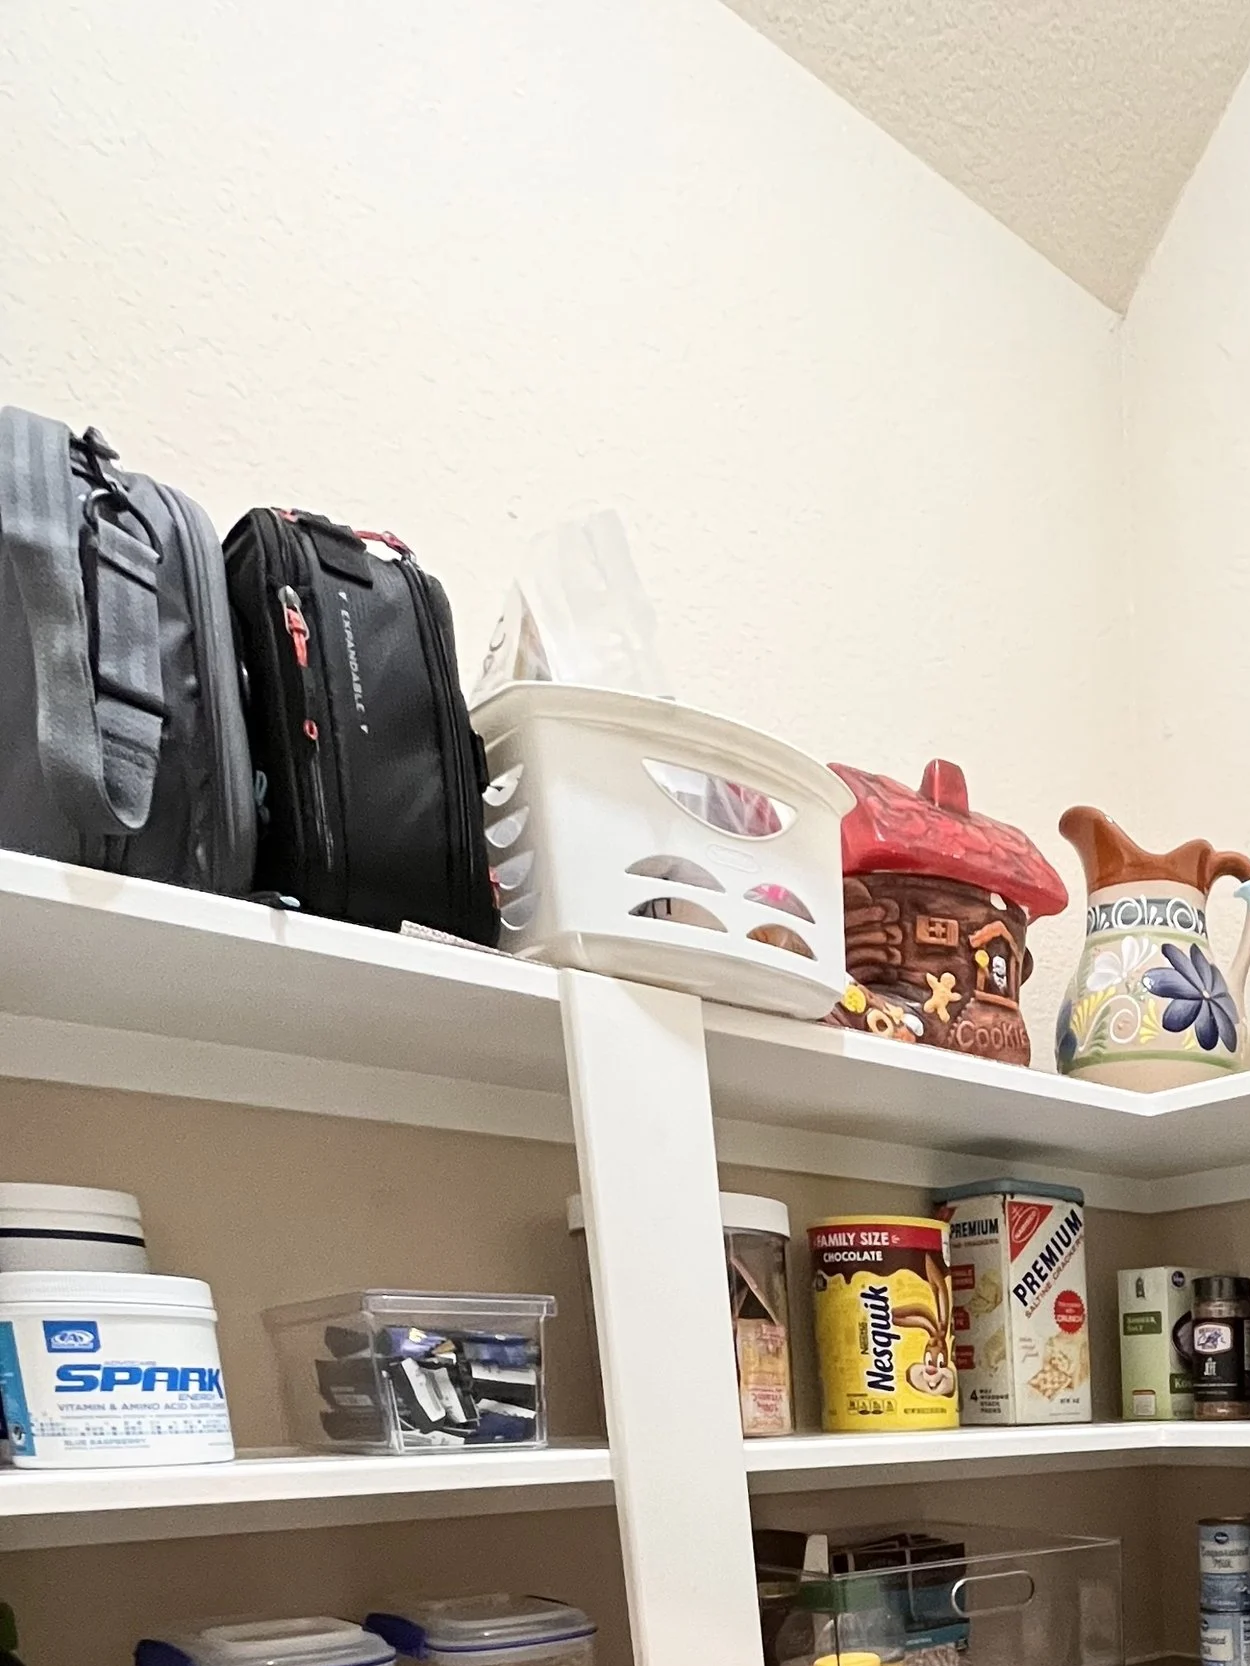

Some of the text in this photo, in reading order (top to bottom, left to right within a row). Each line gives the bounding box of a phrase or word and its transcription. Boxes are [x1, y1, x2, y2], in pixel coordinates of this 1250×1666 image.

[950, 1217, 999, 1238] PREMIUM
[816, 1231, 890, 1248] FAMILY SIZE
[823, 1250, 883, 1263] CHOCOLATE
[1013, 1208, 1083, 1307] PREMIUM
[1024, 1283, 1053, 1320] SALTINE
[860, 1285, 901, 1392] Nesquik
[55, 1363, 224, 1399] SPARK
[969, 1389, 978, 1402] 4
[58, 1402, 188, 1412] VITAMIN & AMINO ACID
